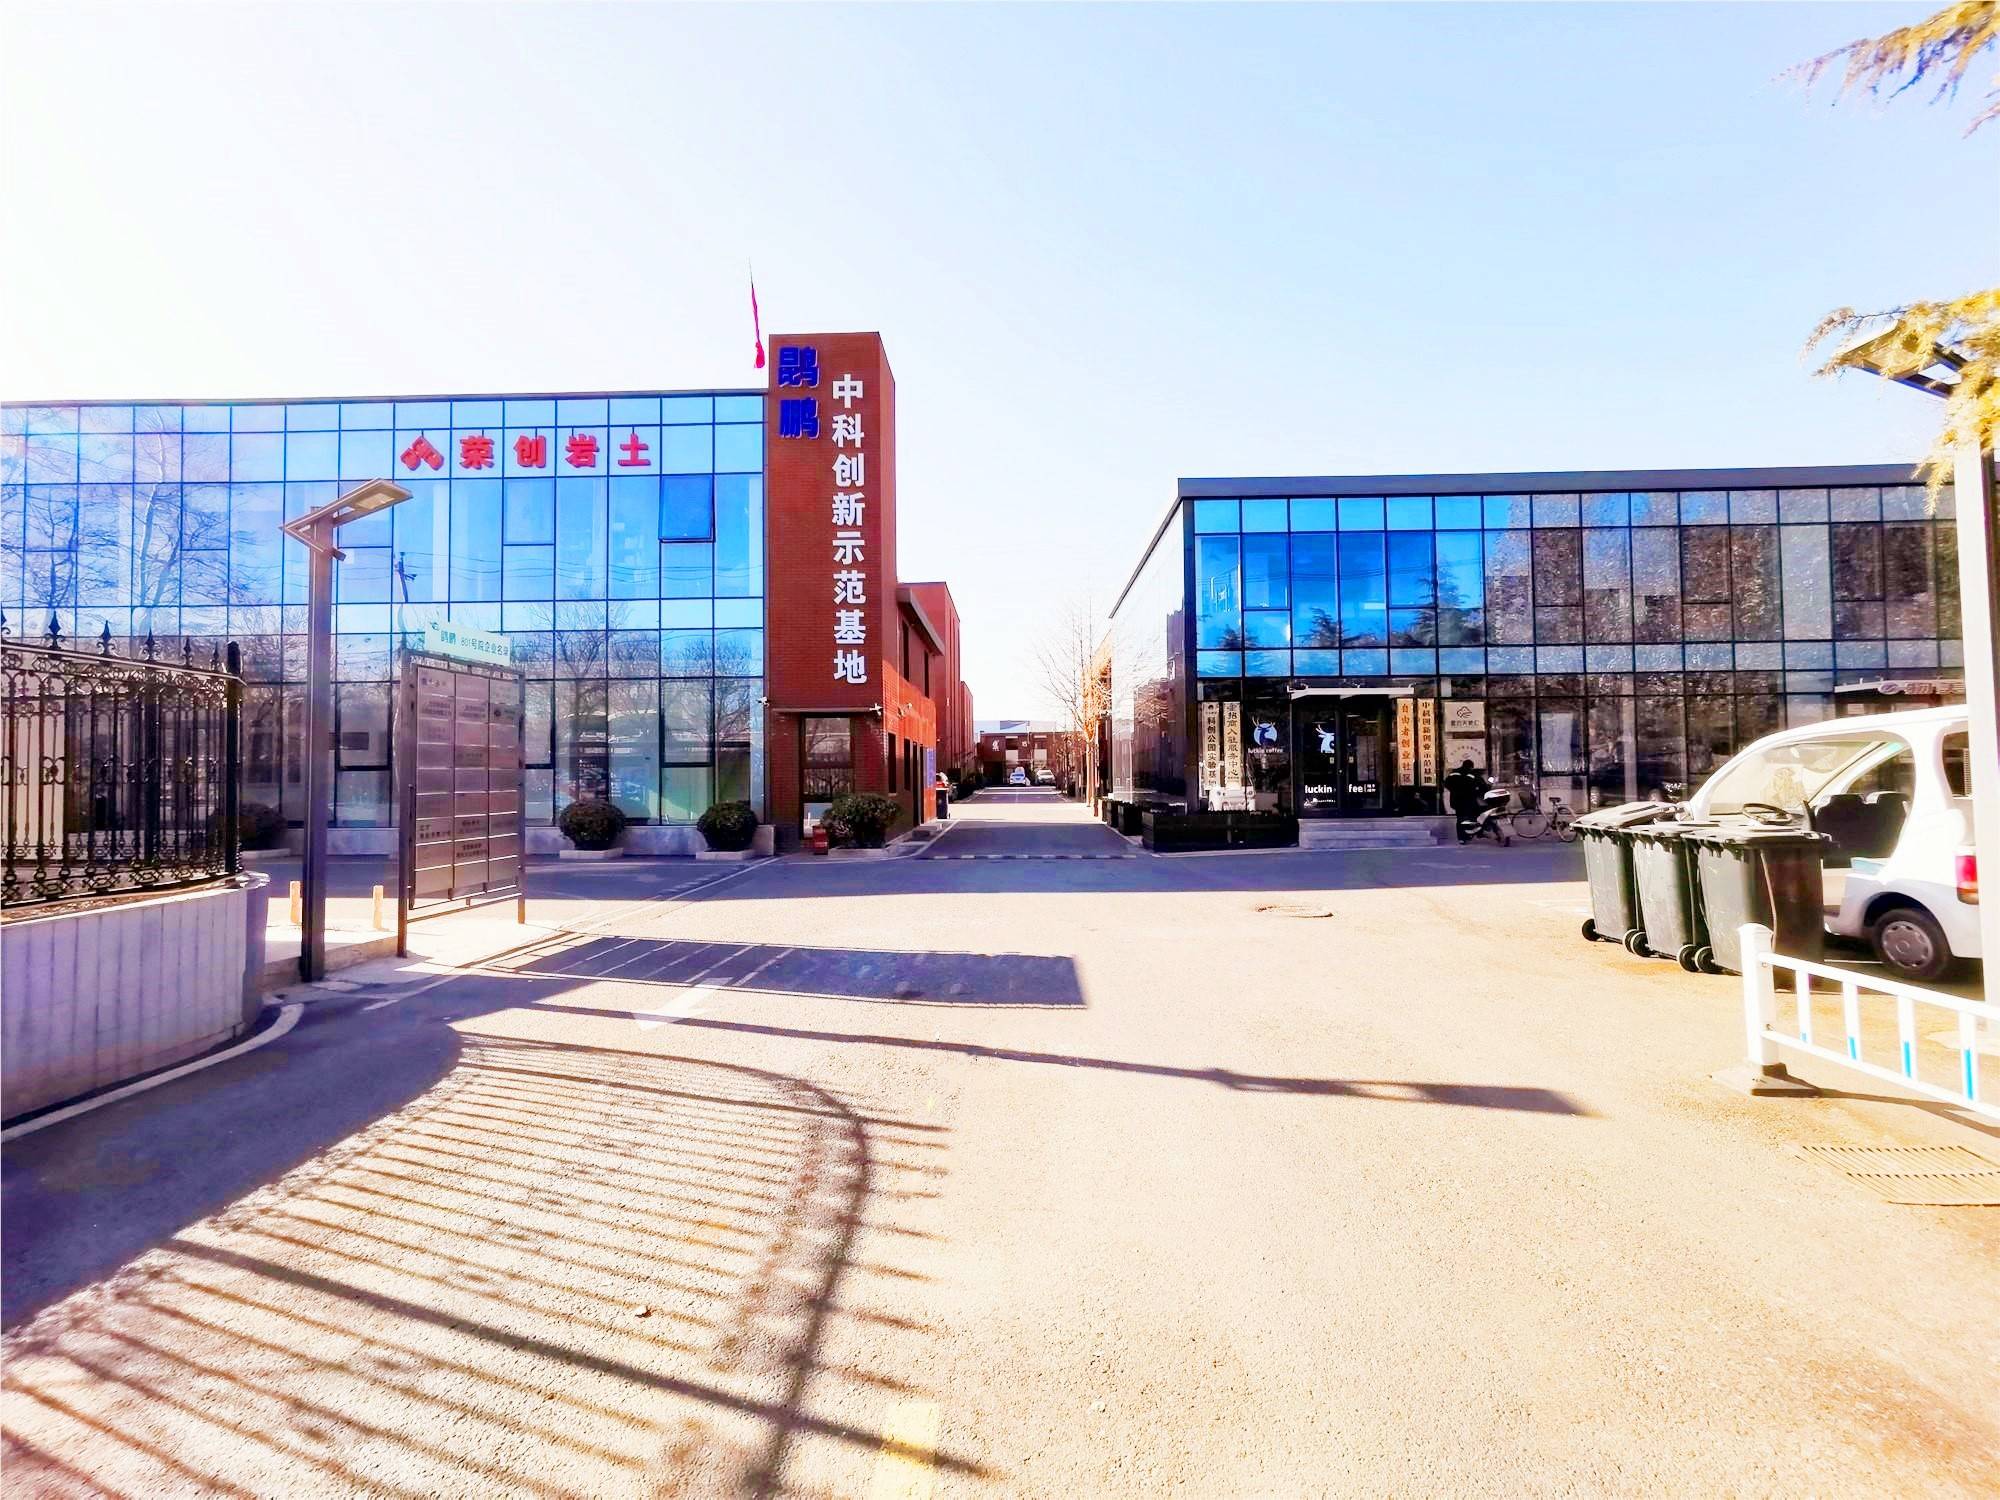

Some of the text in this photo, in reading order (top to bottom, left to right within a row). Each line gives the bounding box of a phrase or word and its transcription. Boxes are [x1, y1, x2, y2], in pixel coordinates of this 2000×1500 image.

[459, 433, 651, 470] 荣创岩土
[831, 374, 867, 684] 中科创新示范基地
[1304, 784, 1333, 794] luckin
